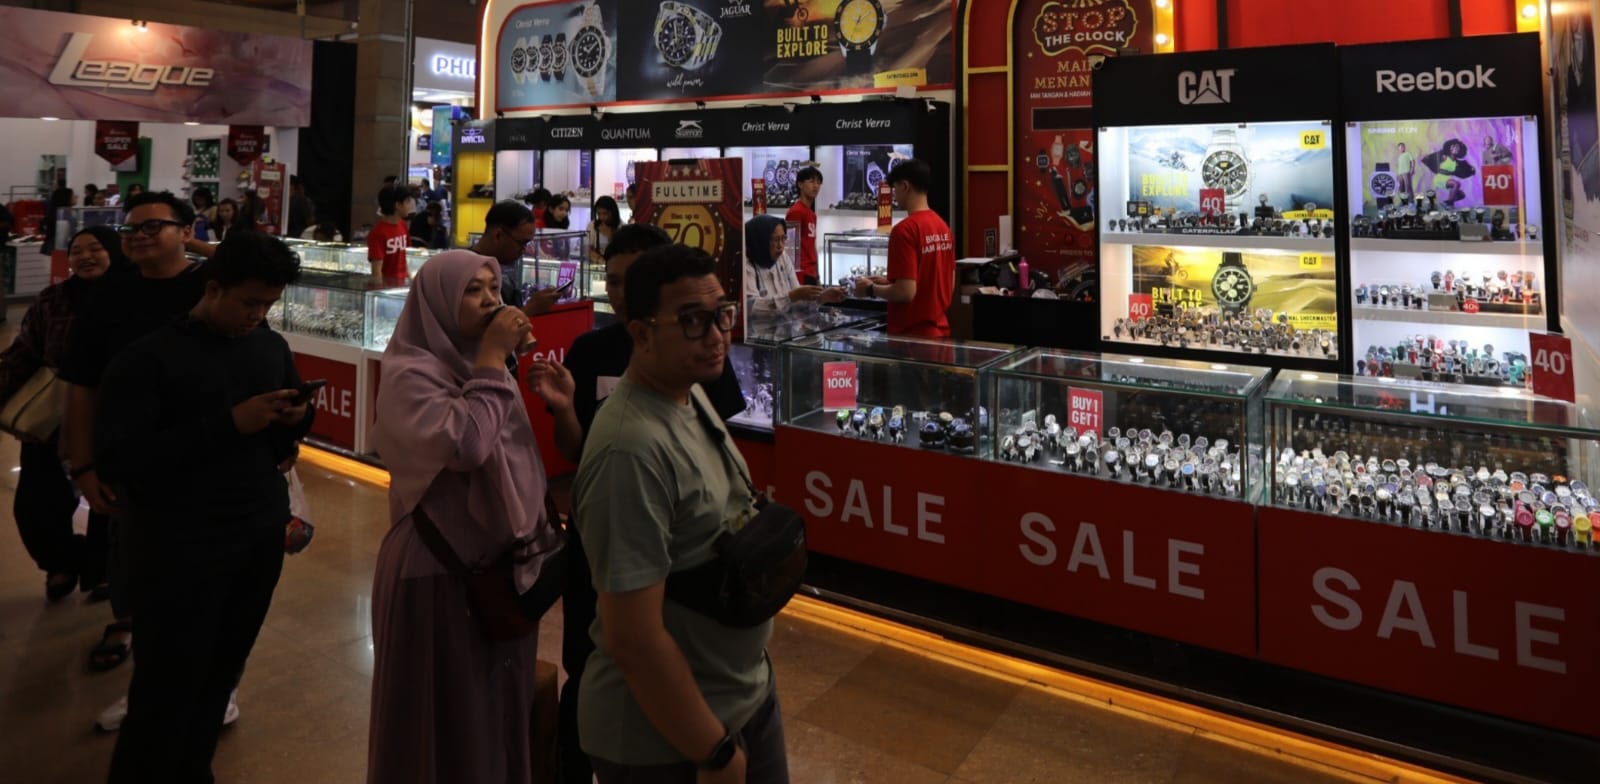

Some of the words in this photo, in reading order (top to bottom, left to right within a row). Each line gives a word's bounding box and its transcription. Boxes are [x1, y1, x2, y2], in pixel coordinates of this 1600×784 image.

[720, 5, 752, 18] JAGUAR
[1043, 7, 1126, 33] STOP
[777, 27, 809, 43] BUILT
[814, 25, 828, 40] TO
[1045, 34, 1071, 47] THE
[1074, 31, 1126, 43] CLOCK
[777, 40, 828, 58] EXPLORE
[48, 32, 215, 90] League
[1178, 68, 1236, 104] CAT
[1376, 65, 1496, 93] Reebok
[741, 122, 765, 132] Christ
[767, 121, 790, 131] Verra
[835, 118, 862, 129] Christ
[865, 117, 891, 128] Verra
[460, 135, 486, 143] INVICTA
[550, 127, 584, 138] CITIZEN
[600, 128, 650, 140] QUANTUM
[1304, 134, 1321, 145] CAT
[655, 186, 718, 197] FULLTIME
[1304, 257, 1317, 265] CAT
[1187, 289, 1202, 302] TO
[827, 377, 853, 389] 100K
[310, 385, 352, 418] ALE
[1072, 396, 1092, 411] BUY
[1093, 399, 1098, 413] 1
[1071, 410, 1092, 426] GET
[1094, 414, 1098, 428] 1
[804, 470, 946, 545] SALE
[1018, 512, 1206, 600] SALE
[1310, 567, 1567, 674] SALE
